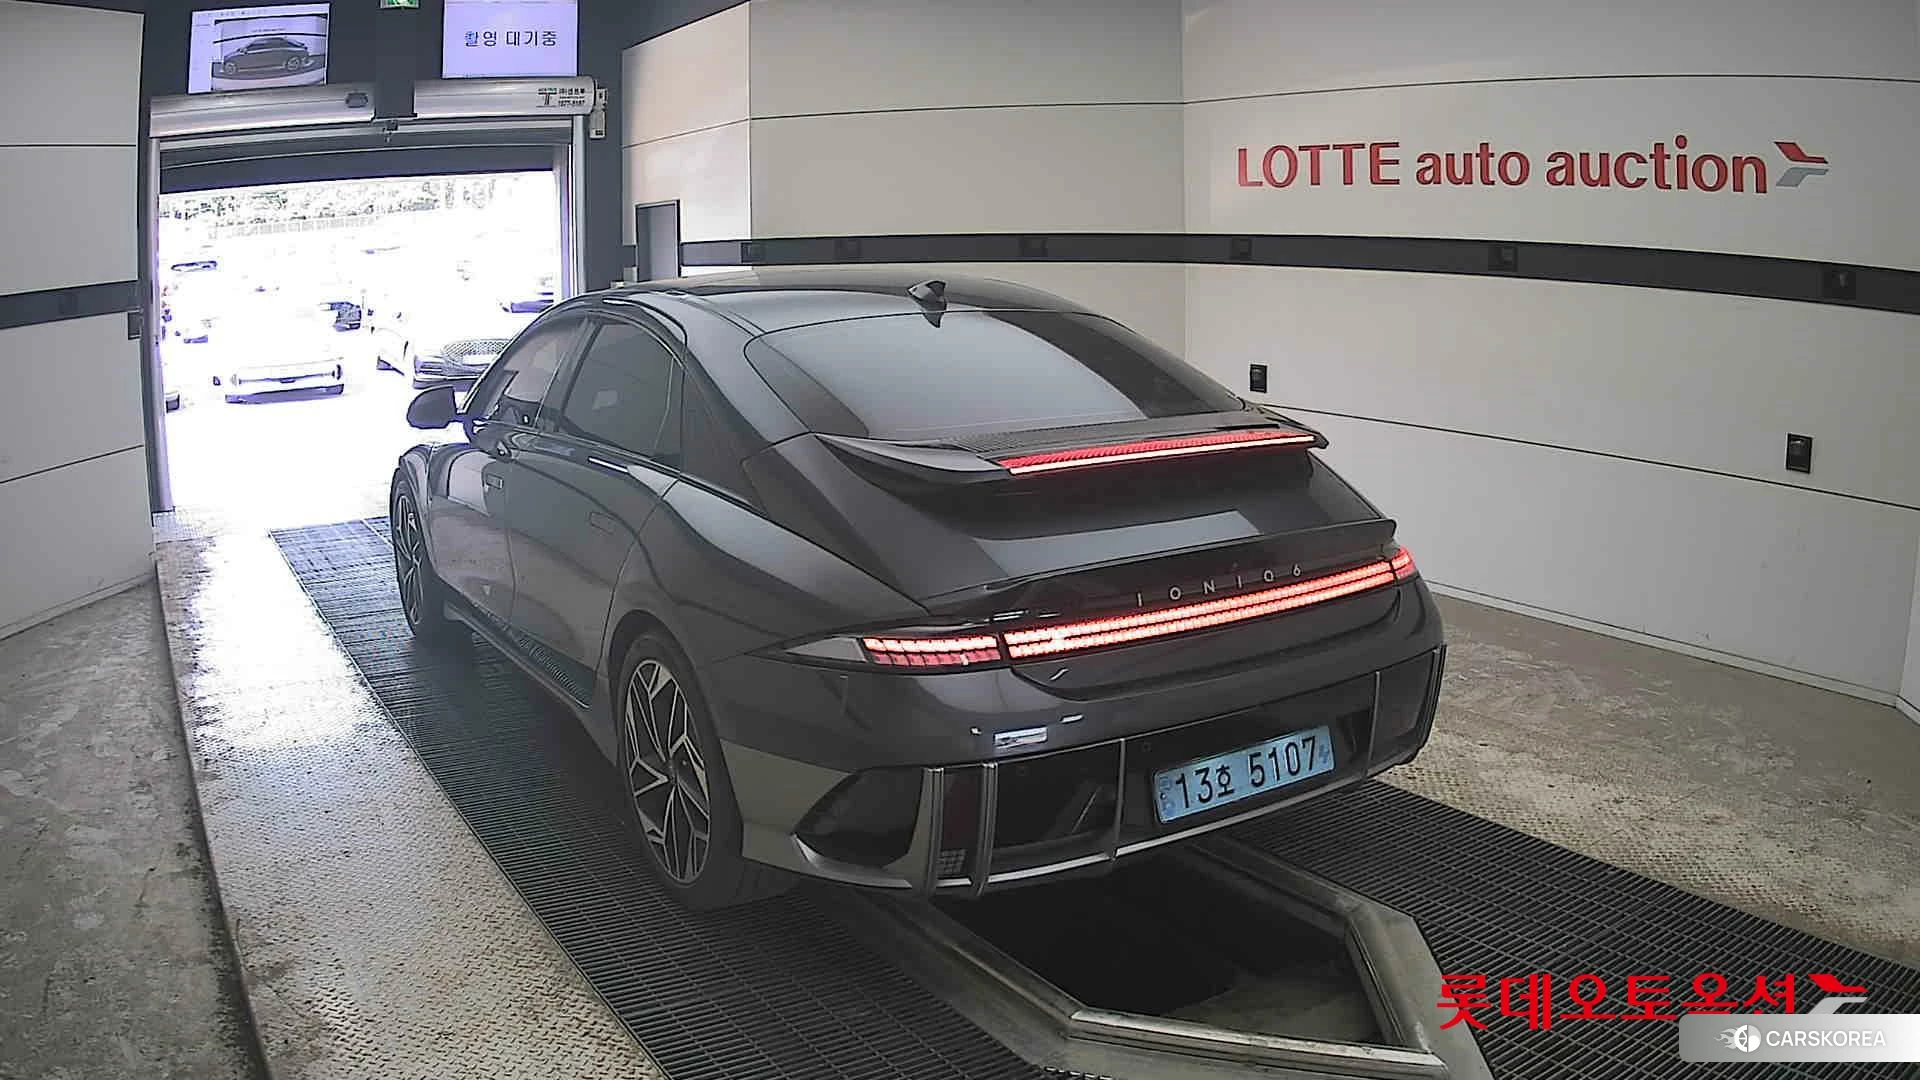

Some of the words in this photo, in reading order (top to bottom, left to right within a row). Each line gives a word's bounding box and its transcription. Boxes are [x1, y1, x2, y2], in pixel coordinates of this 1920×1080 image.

[506, 31, 558, 47] 대기중
[1238, 141, 1400, 187] LOTTE
[1416, 142, 1530, 186] auto
[1545, 135, 1768, 194] auction
[1175, 764, 1236, 809] 13호
[1248, 735, 1317, 788] 5107
